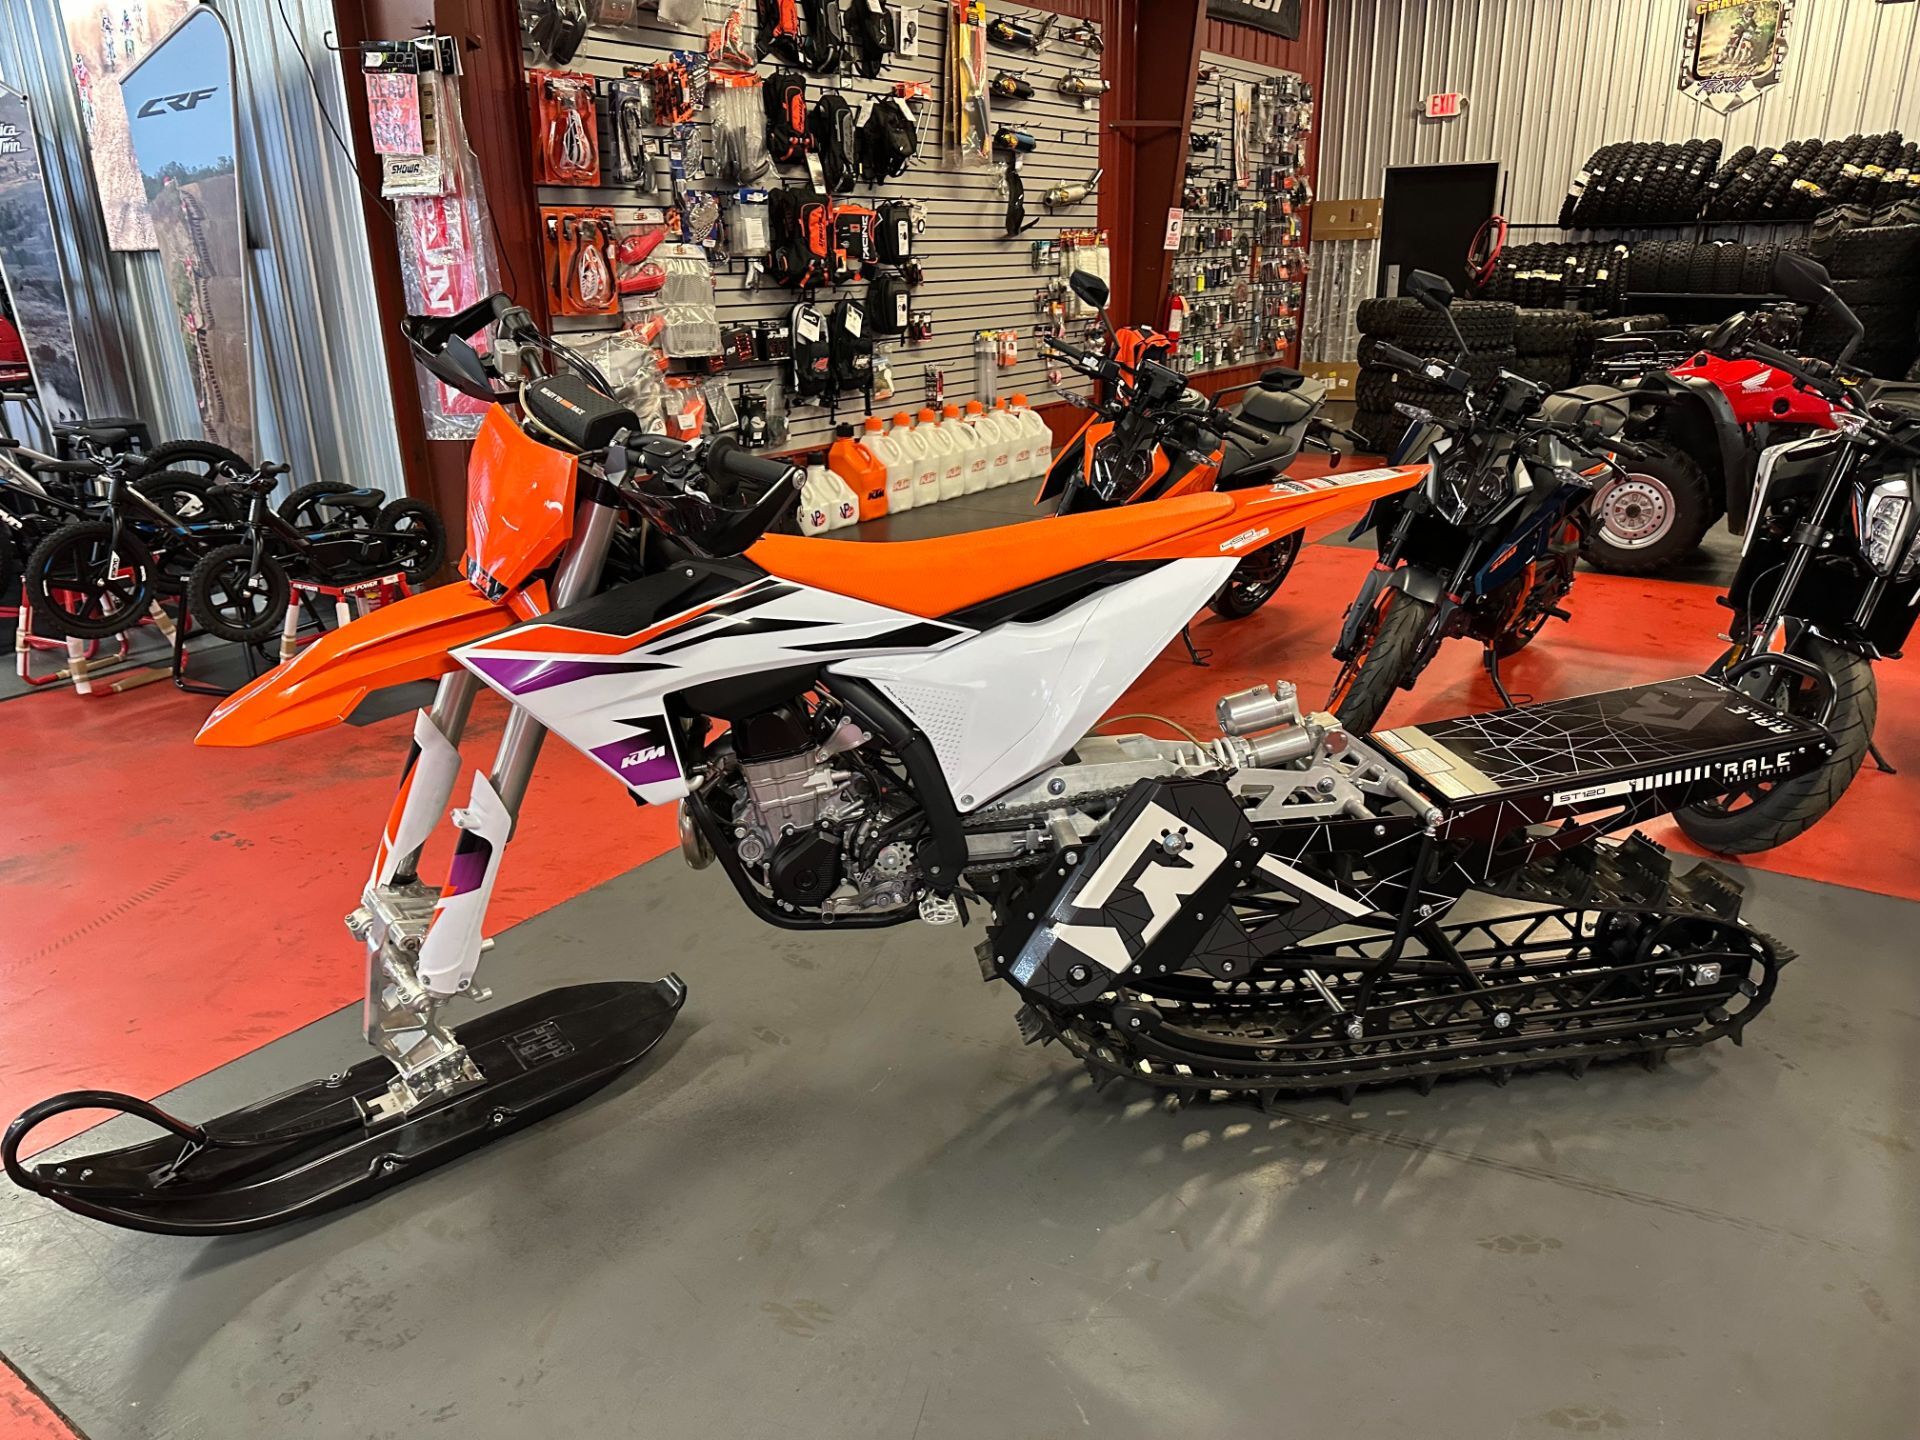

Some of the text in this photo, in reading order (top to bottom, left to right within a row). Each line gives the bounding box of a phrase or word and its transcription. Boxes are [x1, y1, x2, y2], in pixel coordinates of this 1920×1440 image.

[137, 86, 218, 119] CRF
[1431, 94, 1457, 115] EXIT
[391, 163, 420, 175] SHOWA
[861, 215, 871, 260] RACING
[868, 488, 884, 500] KTM
[621, 745, 665, 769] KTM
[1723, 752, 1792, 778] RALE
[1560, 788, 1606, 803] ST120
